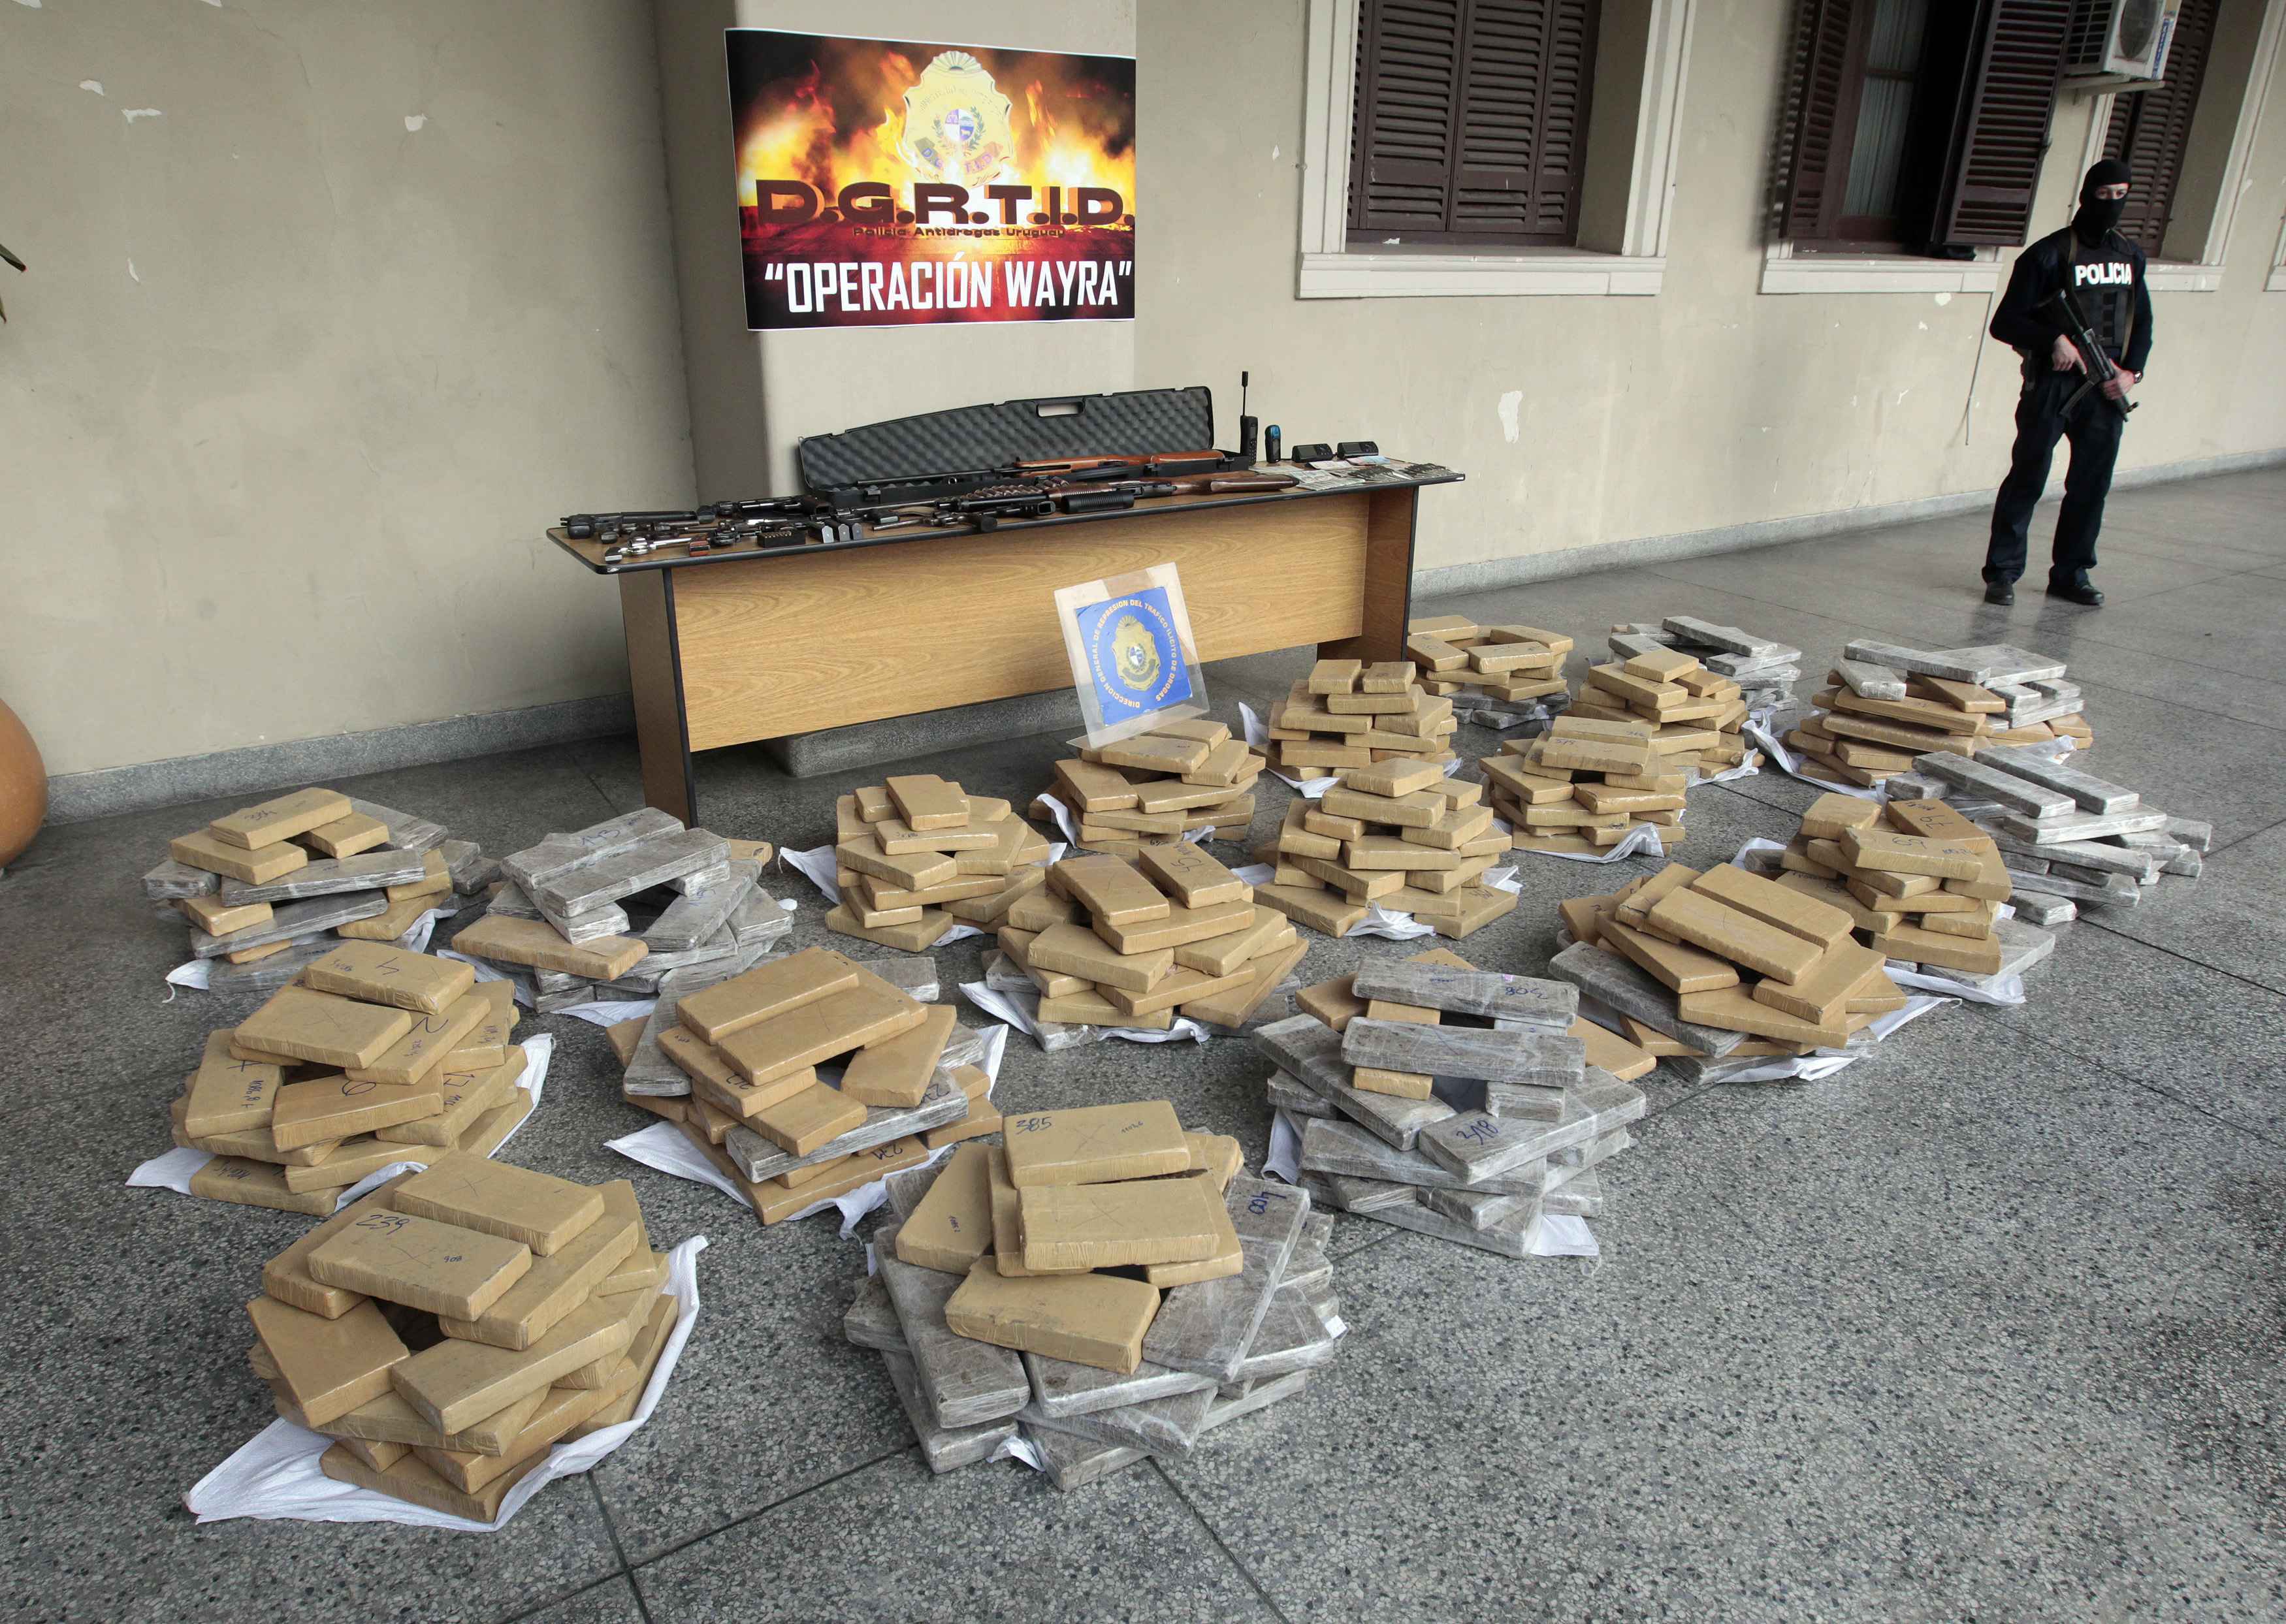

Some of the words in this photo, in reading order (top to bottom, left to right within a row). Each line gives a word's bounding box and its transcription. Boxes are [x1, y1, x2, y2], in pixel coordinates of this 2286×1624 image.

[756, 180, 1135, 225] D.G.R.T.I.D.
[915, 227, 1000, 238] Antidrogas
[1006, 227, 1065, 238] Uruguay
[2074, 262, 2133, 287] POLICIA
[1097, 599, 1129, 628] REPRESION
[1129, 599, 1143, 608] DEL
[1144, 602, 1168, 628] TRAFICO
[1166, 628, 1178, 658] ILICITO
[1170, 660, 1178, 672] DE
[1103, 683, 1140, 709] DIRECCION
[1155, 672, 1175, 701] DROGAS
[1015, 1115, 1053, 1136] 385
[1248, 1191, 1287, 1215] 400
[355, 1214, 410, 1236] 239
